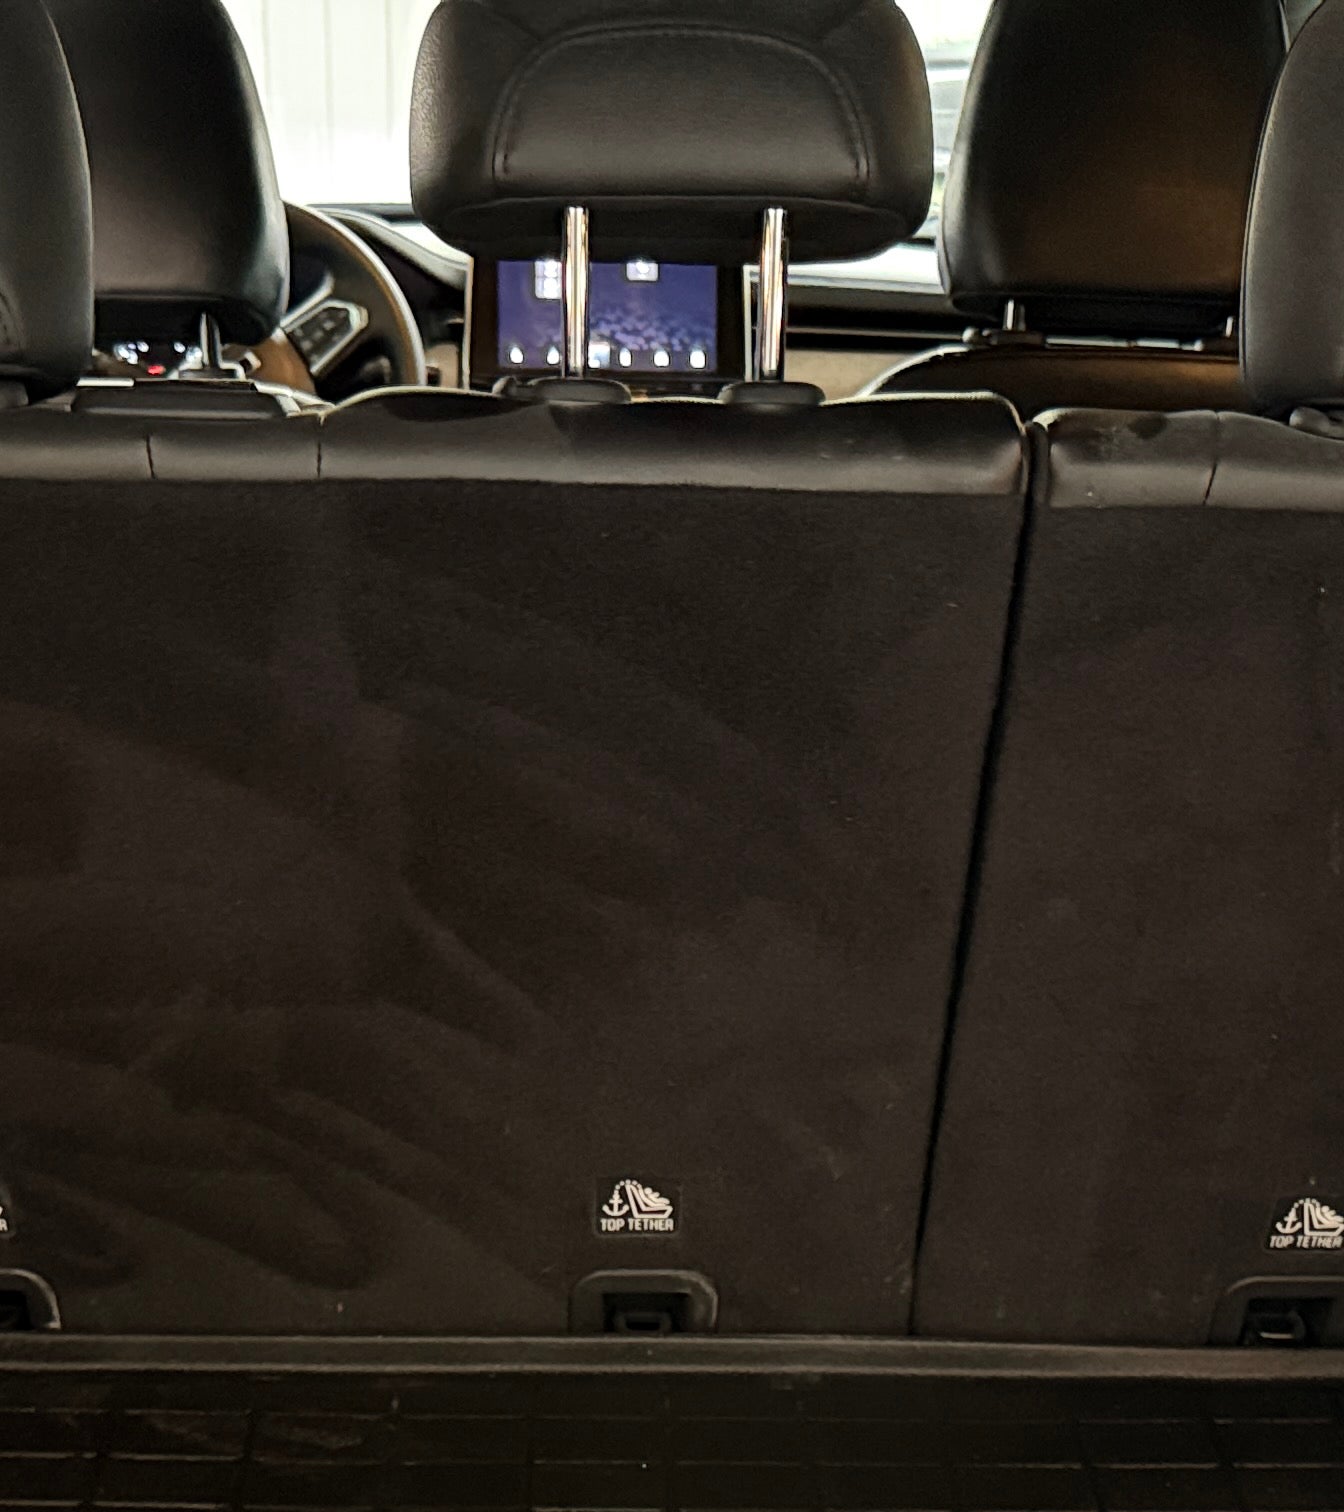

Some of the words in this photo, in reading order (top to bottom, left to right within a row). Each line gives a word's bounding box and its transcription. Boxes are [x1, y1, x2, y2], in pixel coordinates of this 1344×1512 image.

[600, 1218, 626, 1231] TOP
[627, 1218, 674, 1231] TETHER
[1269, 1235, 1295, 1248] TOP
[1296, 1235, 1344, 1248] TETHER
